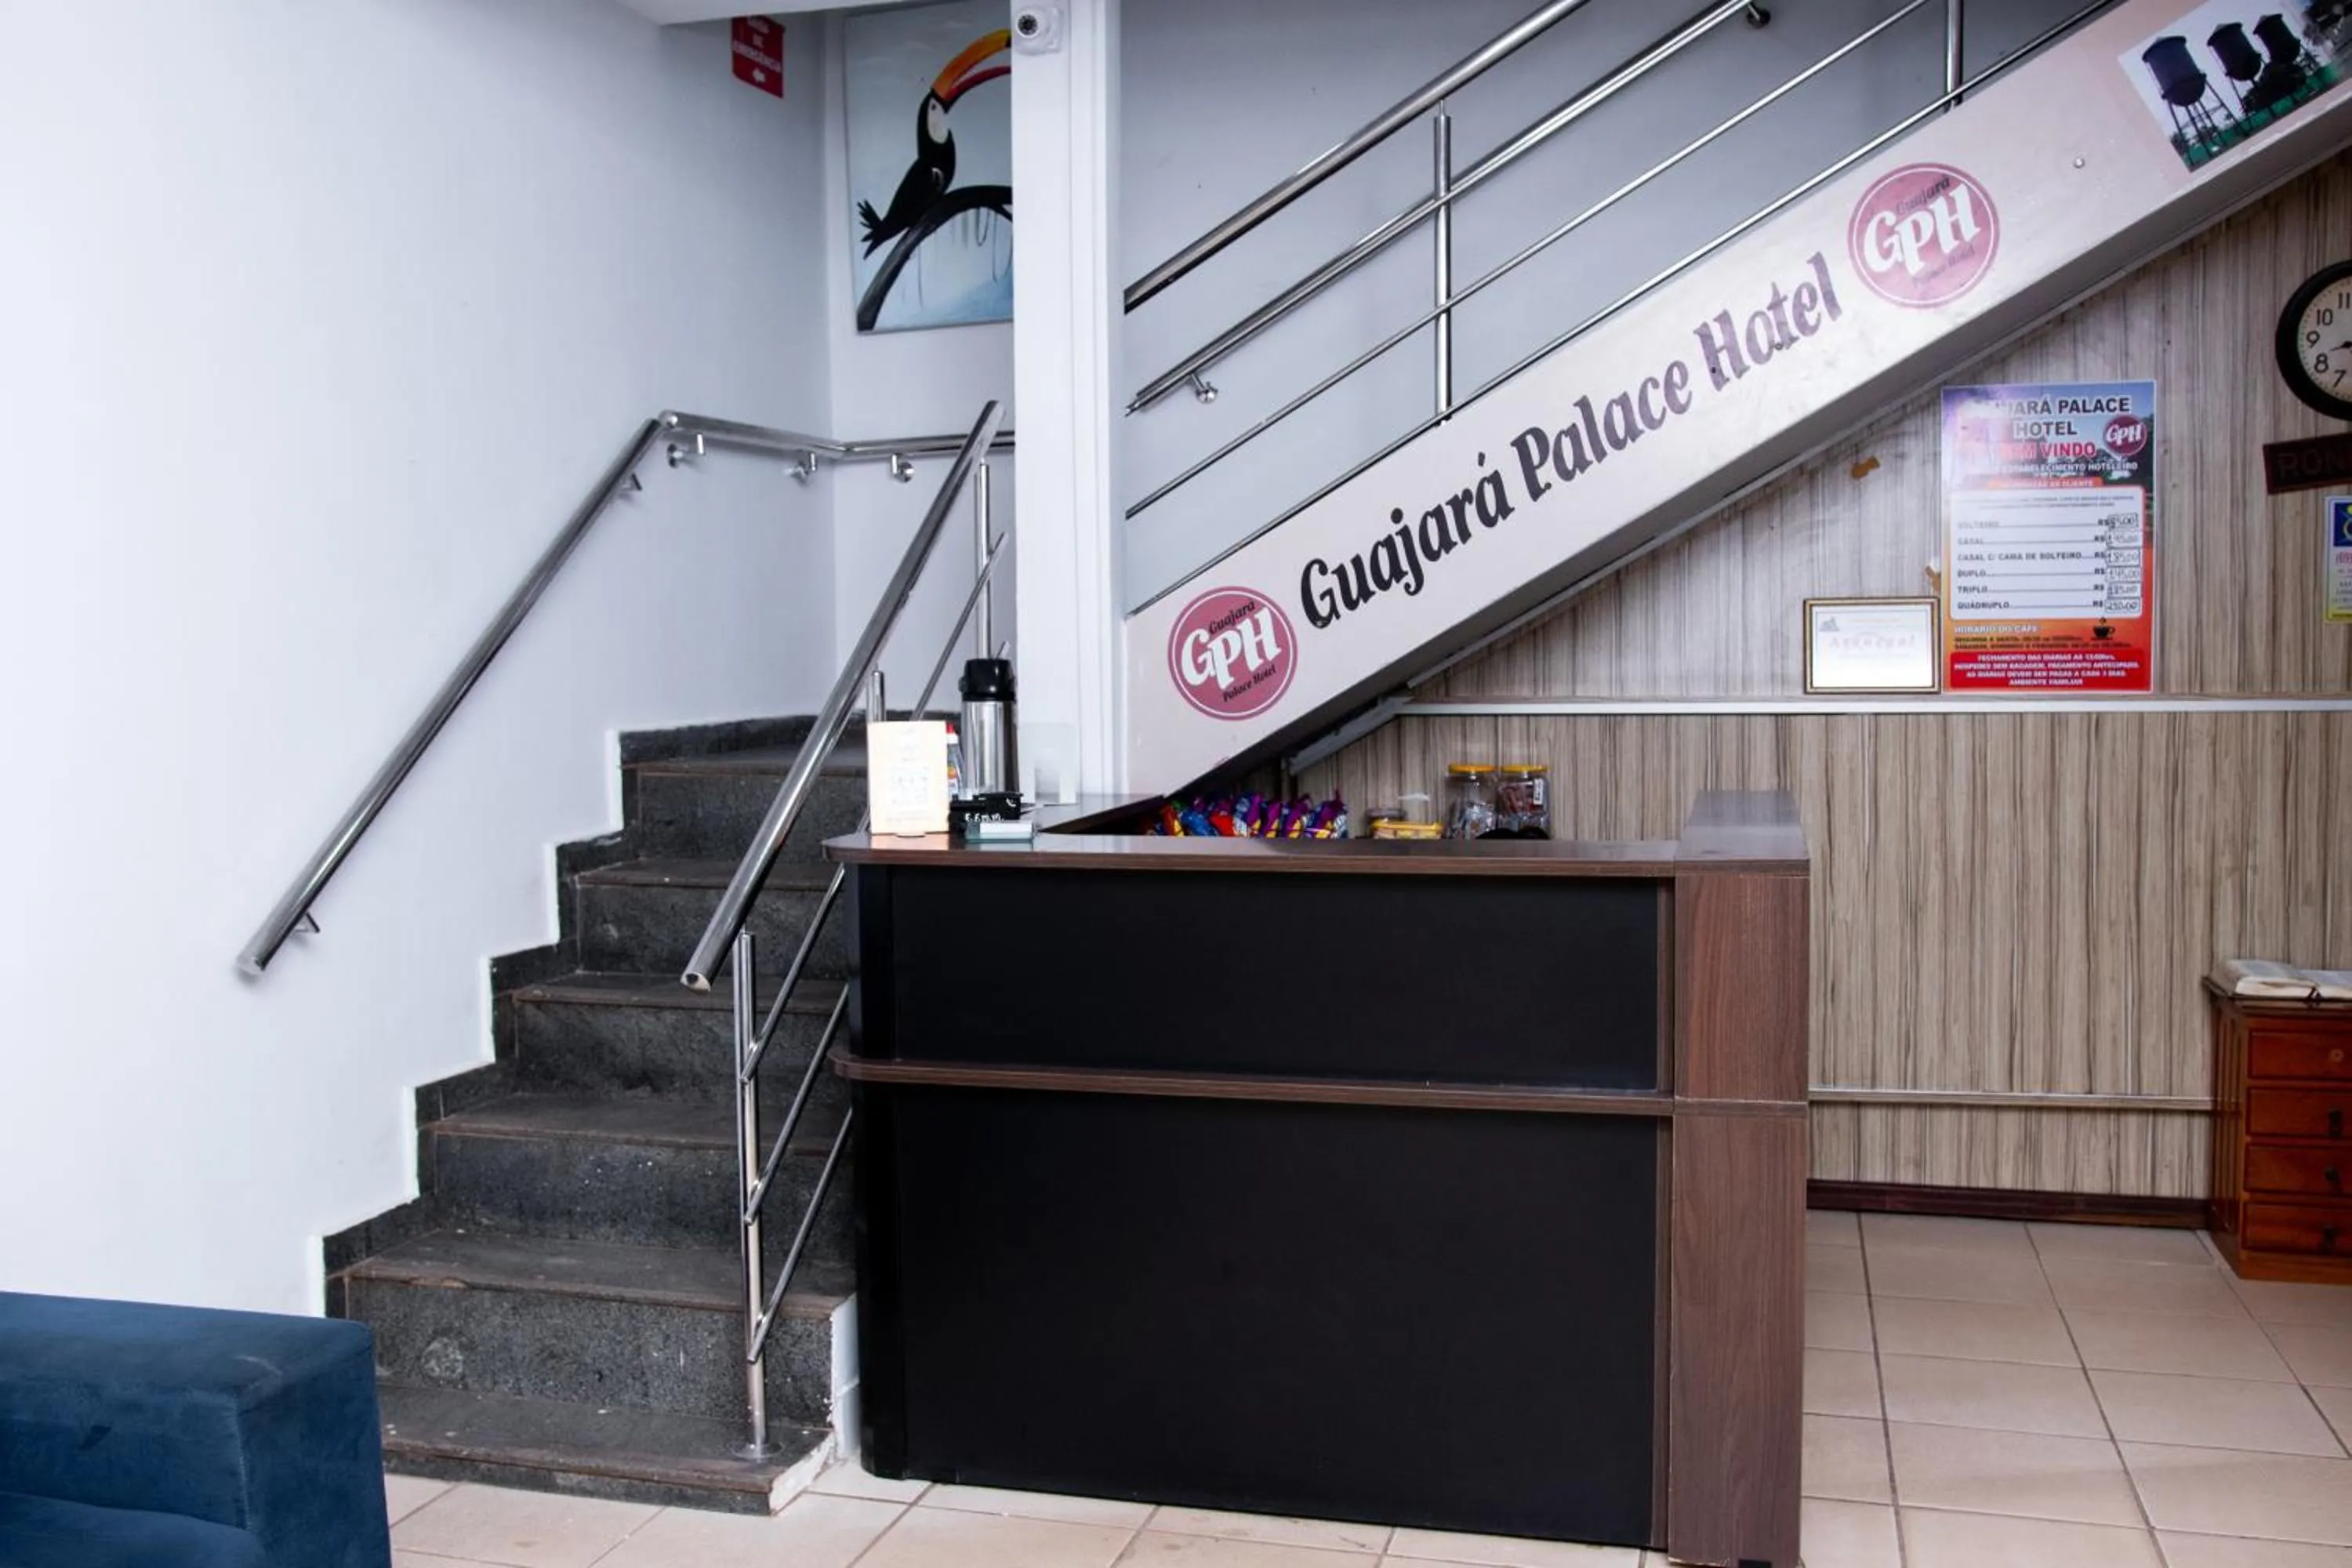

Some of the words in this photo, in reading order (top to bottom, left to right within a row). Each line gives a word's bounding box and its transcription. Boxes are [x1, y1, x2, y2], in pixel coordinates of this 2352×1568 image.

[1864, 183, 1982, 276] GPH
[2338, 292, 2350, 310] 11
[2316, 308, 2333, 326] 10
[2306, 330, 2321, 349] 9
[2314, 353, 2328, 373] 8
[2333, 369, 2347, 388] 7
[2058, 397, 2131, 415] PALACE
[2016, 420, 2078, 436] HOTEL
[2106, 423, 2142, 445] GPH
[1301, 452, 1515, 630] Guajará
[1509, 360, 1693, 503] Palace
[1693, 250, 1843, 392] Hotel
[2041, 441, 2096, 458] VINDO
[1181, 606, 1283, 691] GPH
[1253, 663, 1277, 684] Hotel
